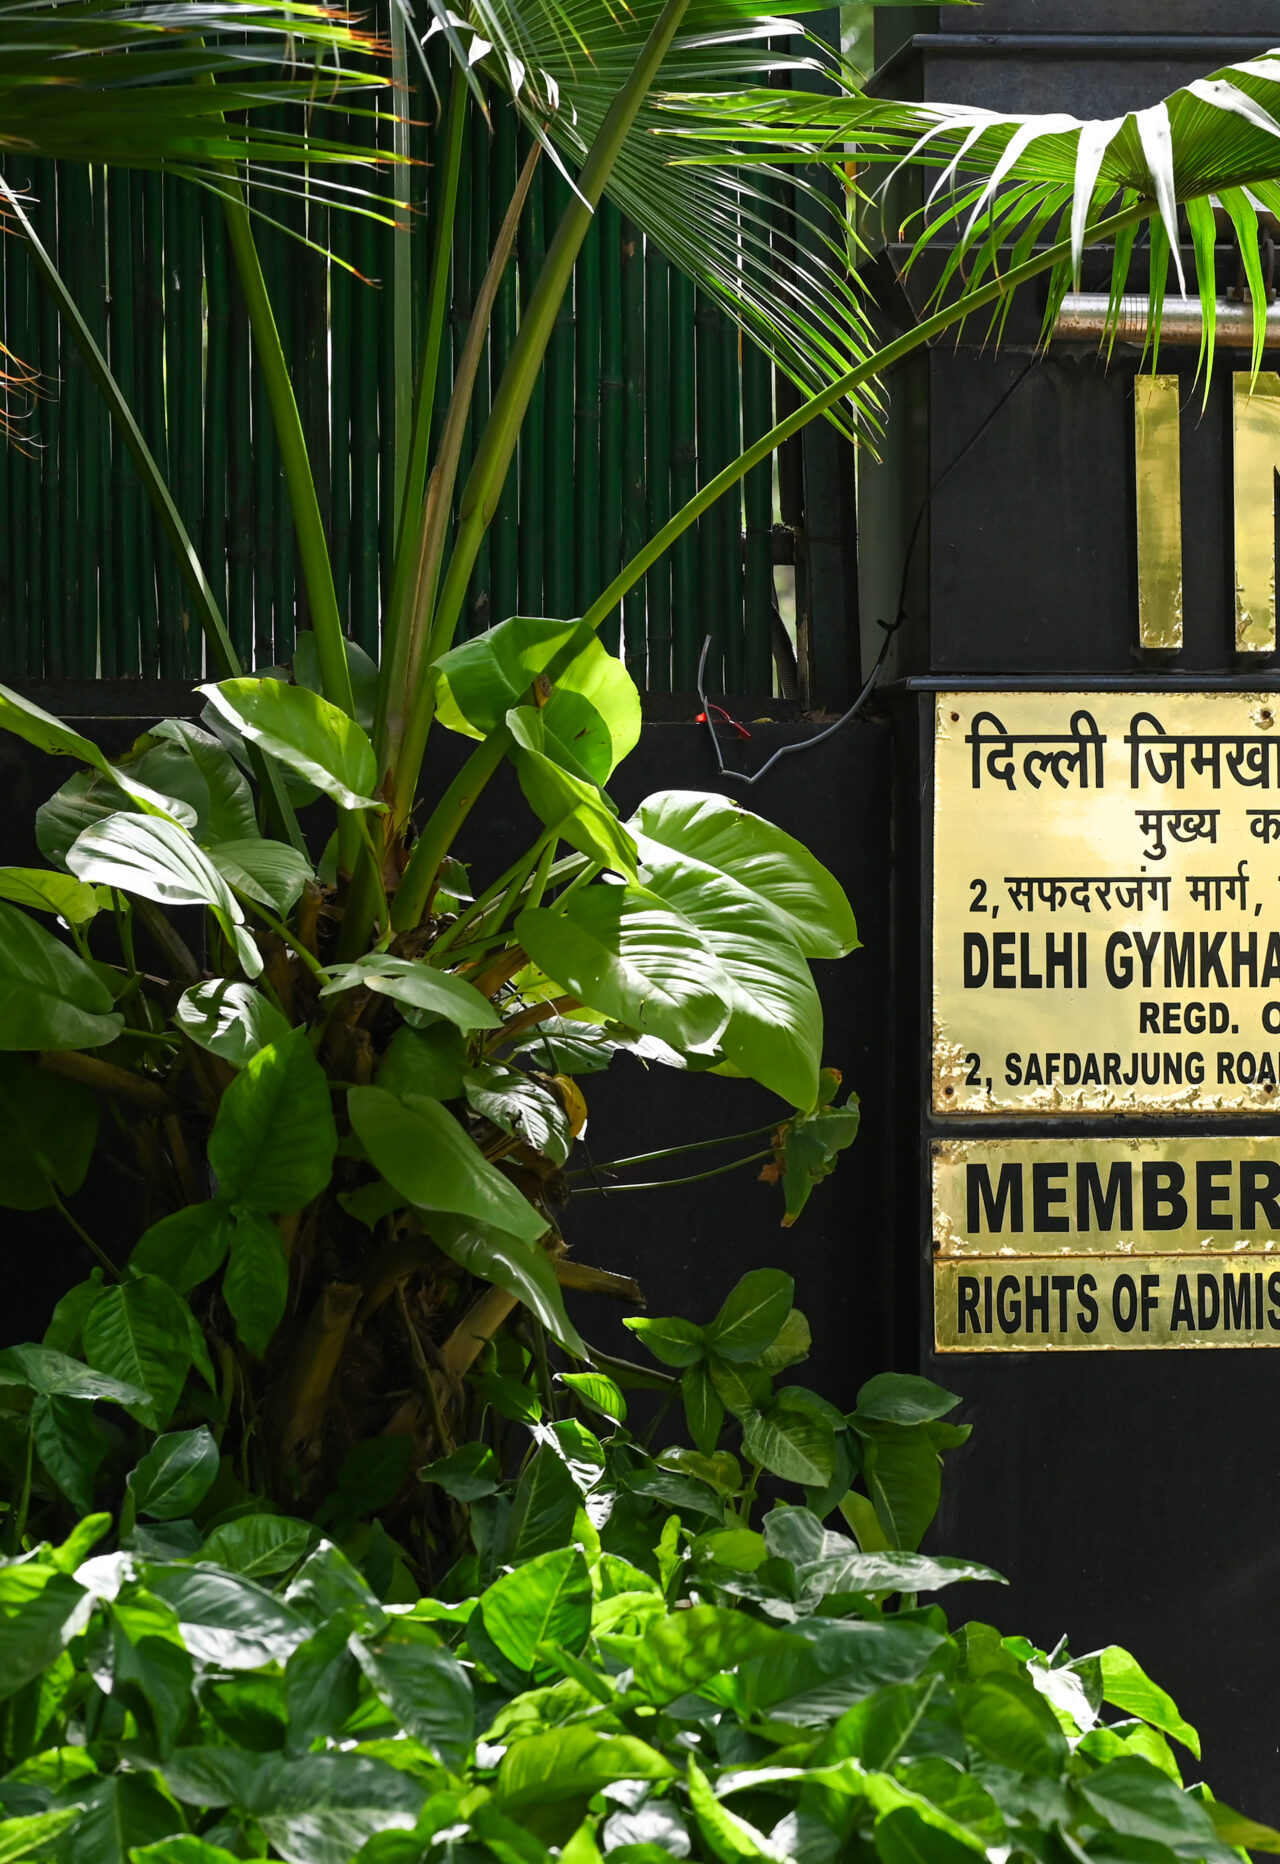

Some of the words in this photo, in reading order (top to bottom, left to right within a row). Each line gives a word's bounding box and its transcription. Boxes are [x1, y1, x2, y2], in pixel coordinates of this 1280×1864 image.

[964, 709, 1107, 791] दिल्ली
[1135, 809, 1221, 861] मुख्य
[963, 931, 1087, 989] DELHI
[1139, 1002, 1239, 1035] REGD.
[964, 1053, 993, 1094] 2,
[1004, 1052, 1205, 1086] SAFDARJUNG
[957, 1273, 1099, 1335] RIGHTS
[1112, 1273, 1160, 1333] OF
